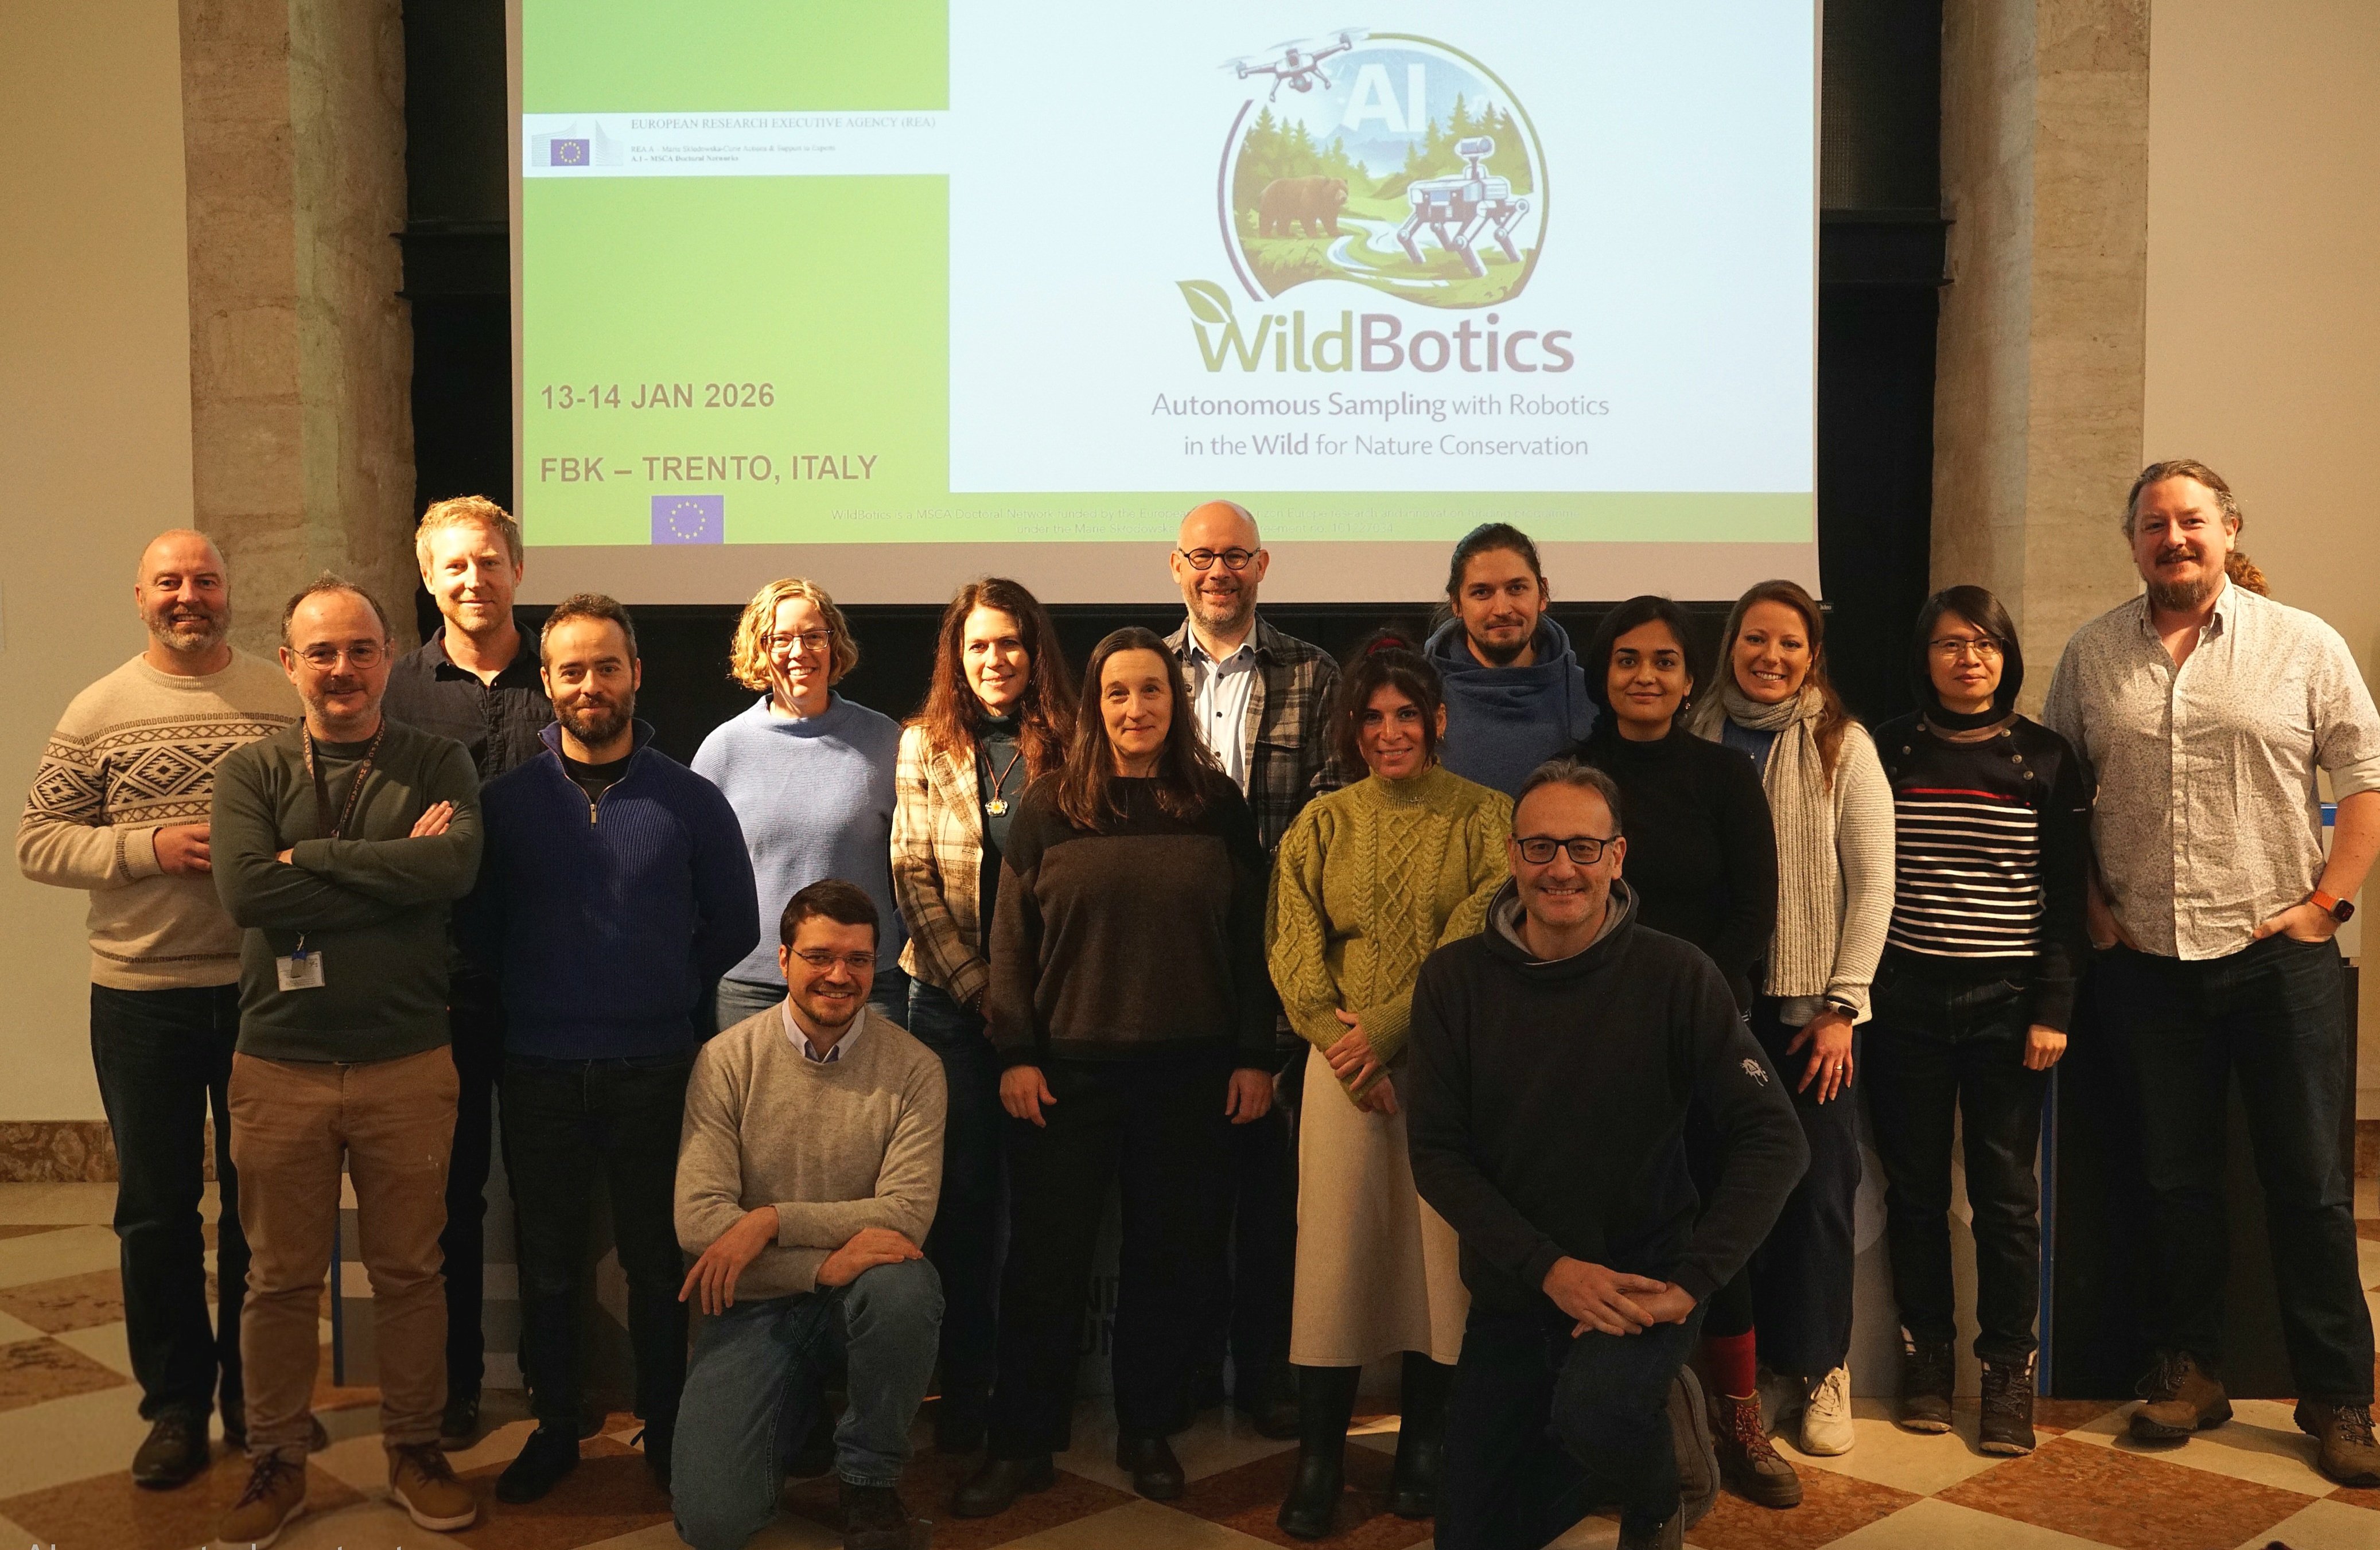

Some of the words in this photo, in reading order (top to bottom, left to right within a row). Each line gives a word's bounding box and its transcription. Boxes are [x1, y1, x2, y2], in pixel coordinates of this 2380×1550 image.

[1341, 62, 1427, 133] AI
[631, 119, 698, 129] EUROPEAN
[702, 118, 768, 128] RESEARCH
[772, 118, 842, 128] EXECUTIVE
[846, 117, 897, 127] AGENCY
[901, 116, 936, 128] (REA)
[1191, 310, 1574, 373] WildBotics
[542, 384, 621, 410] 13-14
[631, 384, 692, 409] JAN
[705, 383, 774, 408] 2026
[1151, 392, 1321, 416] Autonomous
[1328, 391, 1446, 423] Sampling
[1452, 394, 1502, 415] with
[1510, 393, 1609, 416] Robotics
[1185, 435, 1203, 455] in
[1210, 434, 1247, 455] the
[1253, 433, 1308, 455] Wild
[1316, 434, 1348, 455] for
[1356, 435, 1433, 455] Nature
[1440, 434, 1588, 455] Conservation
[541, 457, 604, 482] FBK
[642, 455, 779, 484] TRENTO,
[793, 455, 877, 480] ITALY
[831, 509, 891, 520] WildBotics
[895, 509, 903, 519] is
[907, 511, 912, 519] a
[916, 509, 952, 519] MSCA
[955, 508, 1002, 519] Doctoral
[1007, 508, 1053, 519] Network
[1057, 508, 1097, 519] funded
[1101, 508, 1114, 521] by
[1118, 508, 1135, 519] the
[1140, 508, 1185, 520] Europea
[1017, 523, 1049, 533] under
[1053, 523, 1071, 533] the
